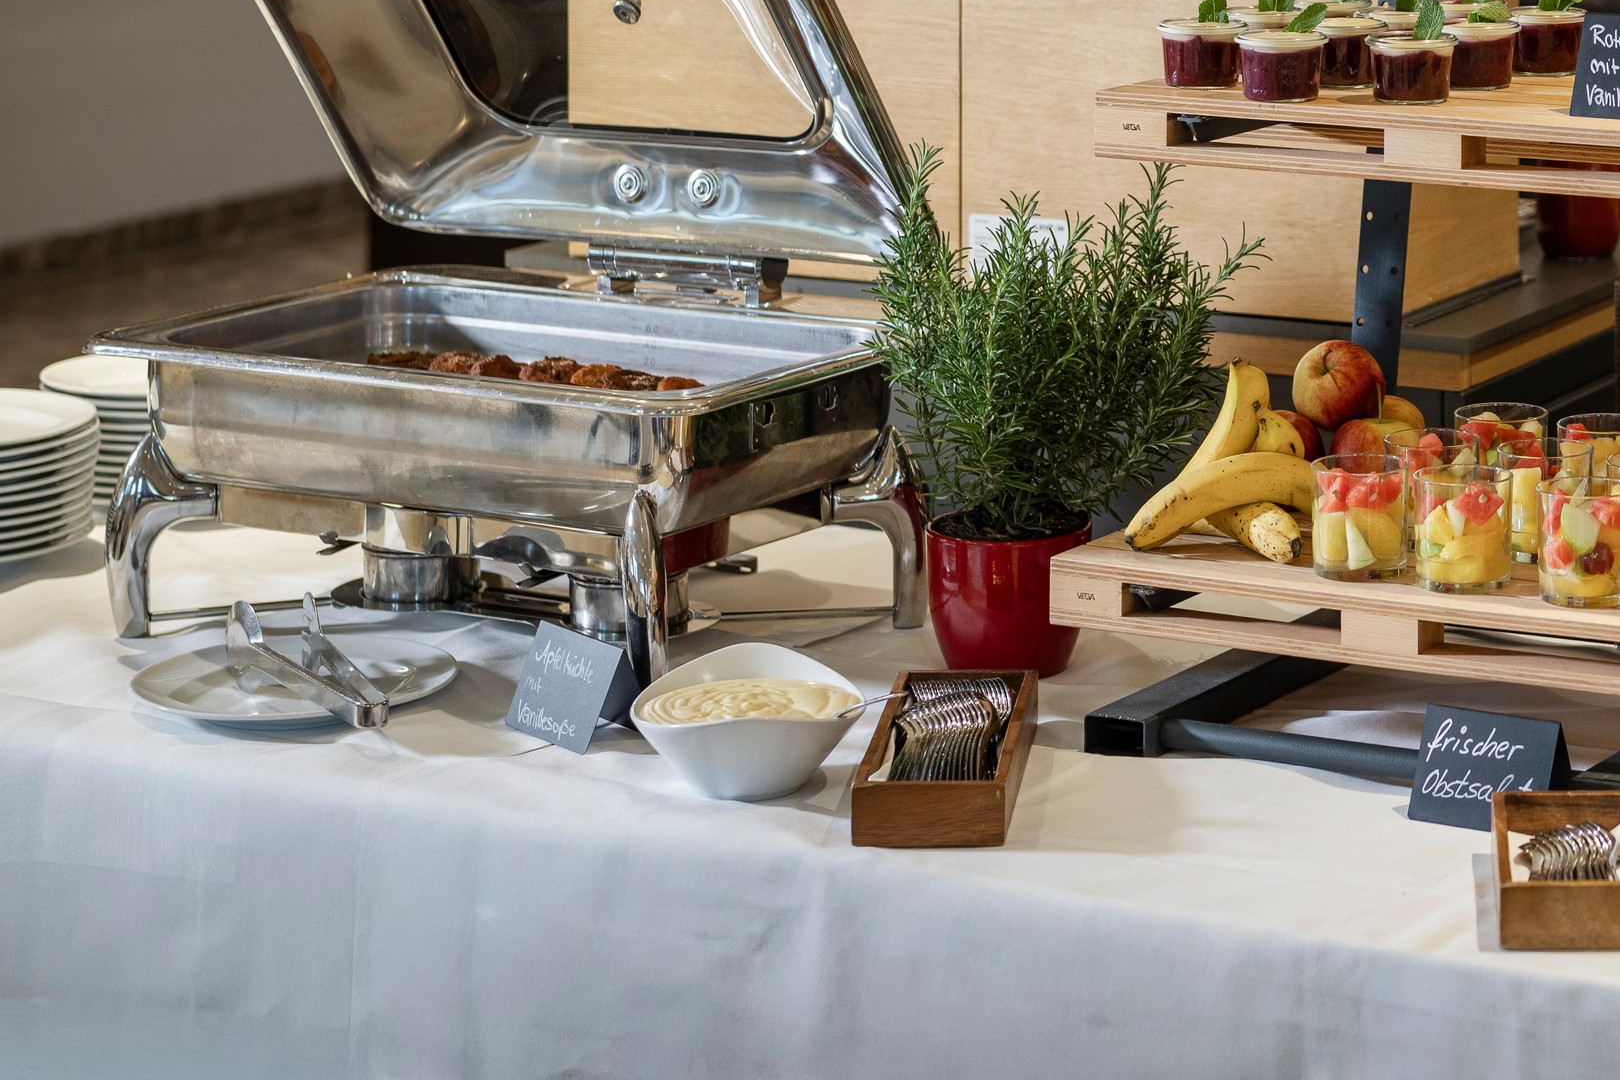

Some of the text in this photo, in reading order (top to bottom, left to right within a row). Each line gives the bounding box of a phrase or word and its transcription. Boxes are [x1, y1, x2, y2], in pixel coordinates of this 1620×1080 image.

[1590, 58, 1620, 75] mit
[1122, 123, 1141, 131] VEGA
[1076, 591, 1096, 601] VEGA
[524, 676, 542, 693] mit
[517, 699, 576, 741] Vanillesoße
[1426, 718, 1524, 762] frischer
